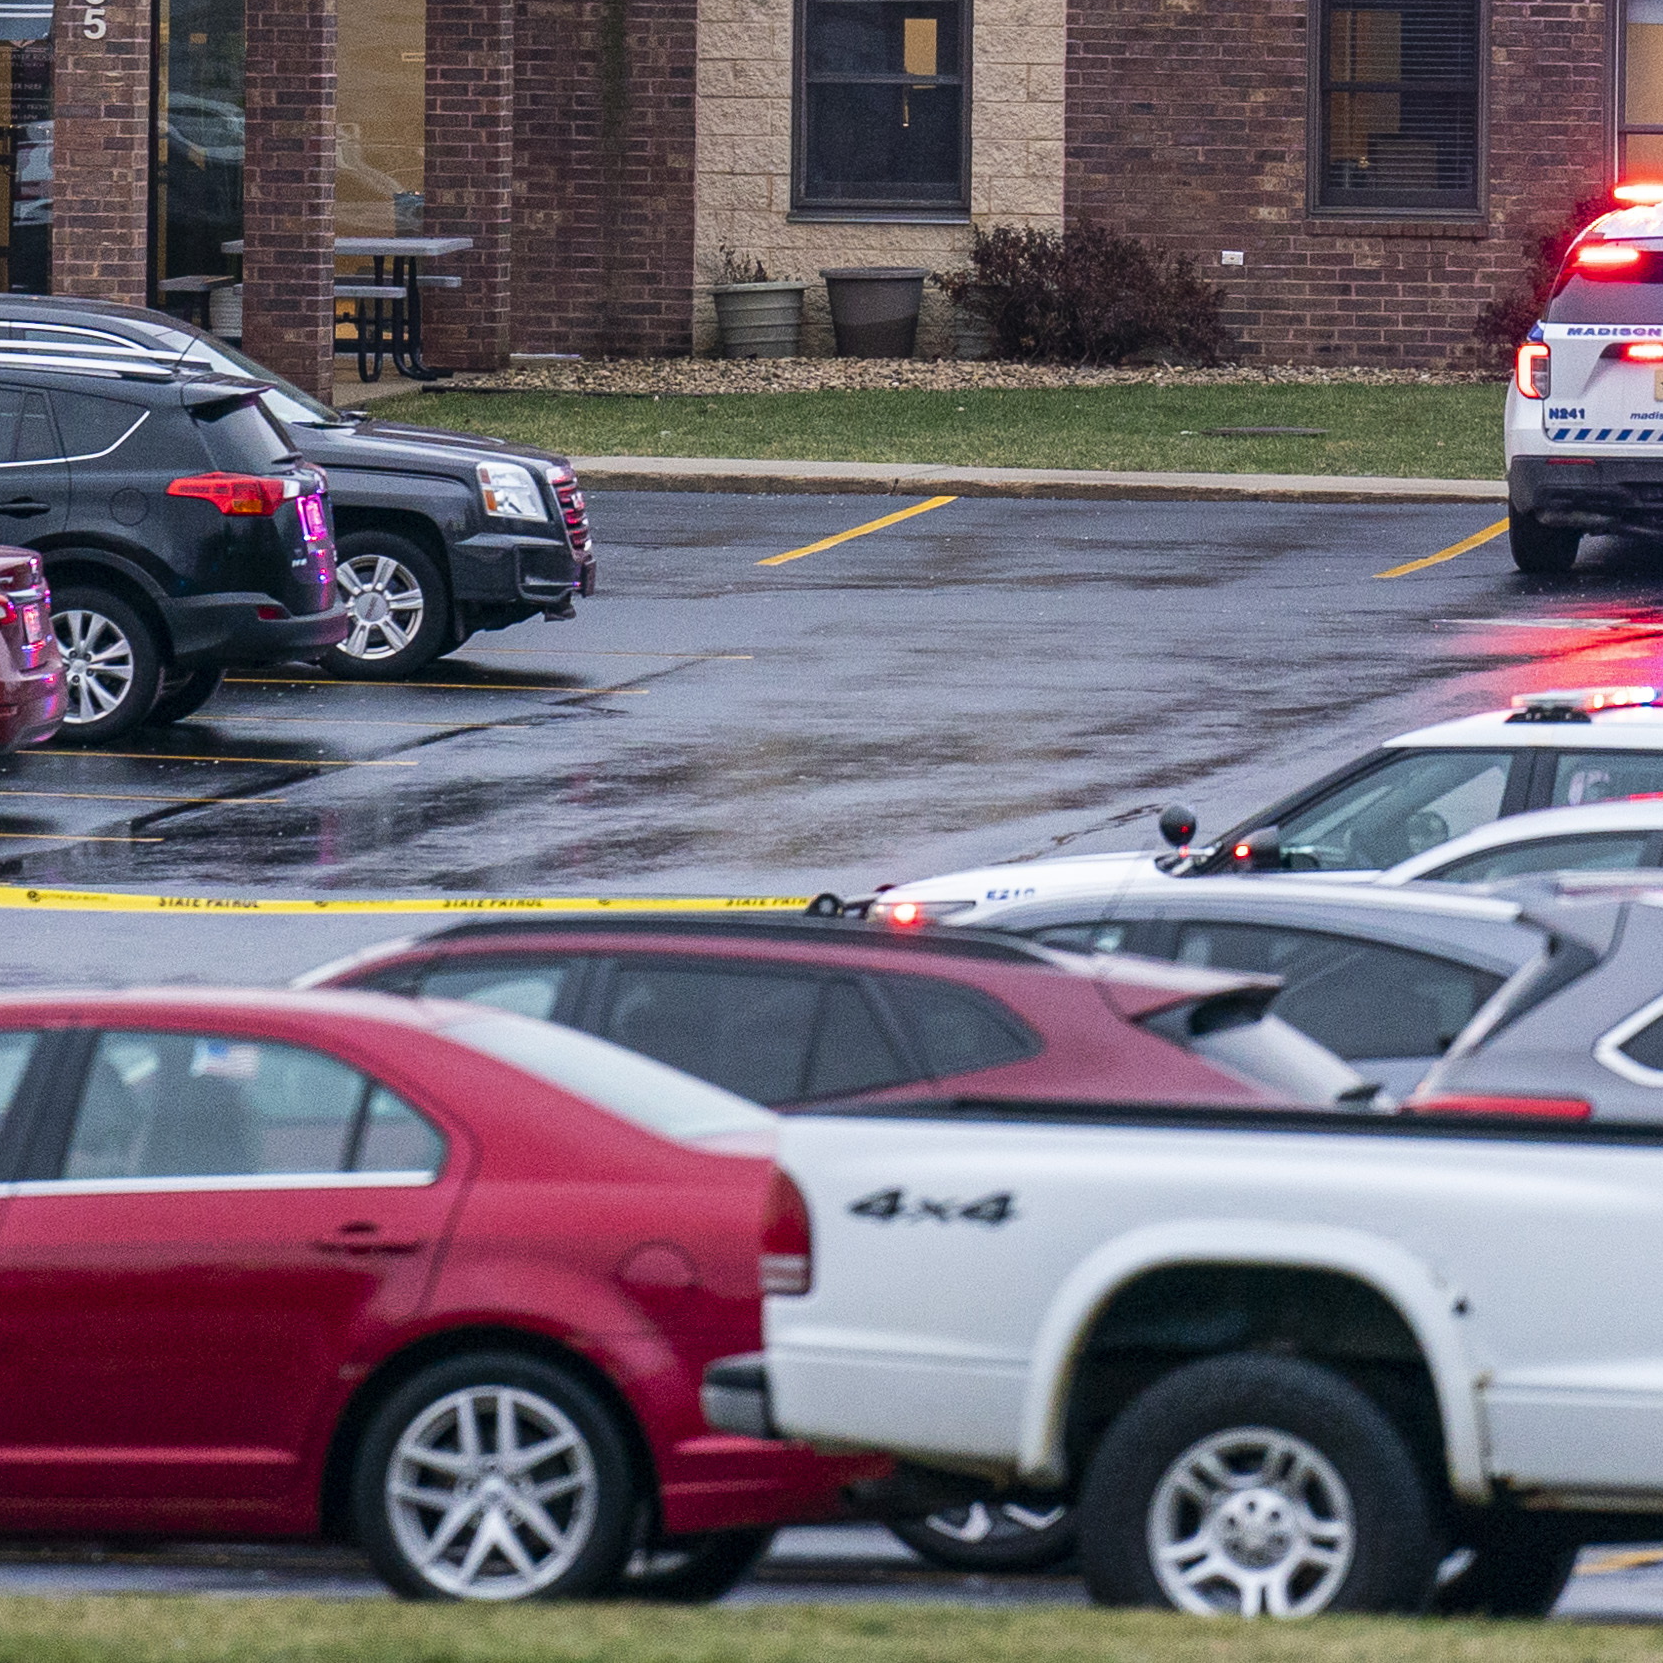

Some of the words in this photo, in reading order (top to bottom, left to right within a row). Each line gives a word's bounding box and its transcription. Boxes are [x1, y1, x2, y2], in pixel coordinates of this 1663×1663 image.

[1567, 327, 1663, 337] MADISON
[1549, 407, 1586, 420] N241
[845, 1186, 1015, 1226] 4x4
